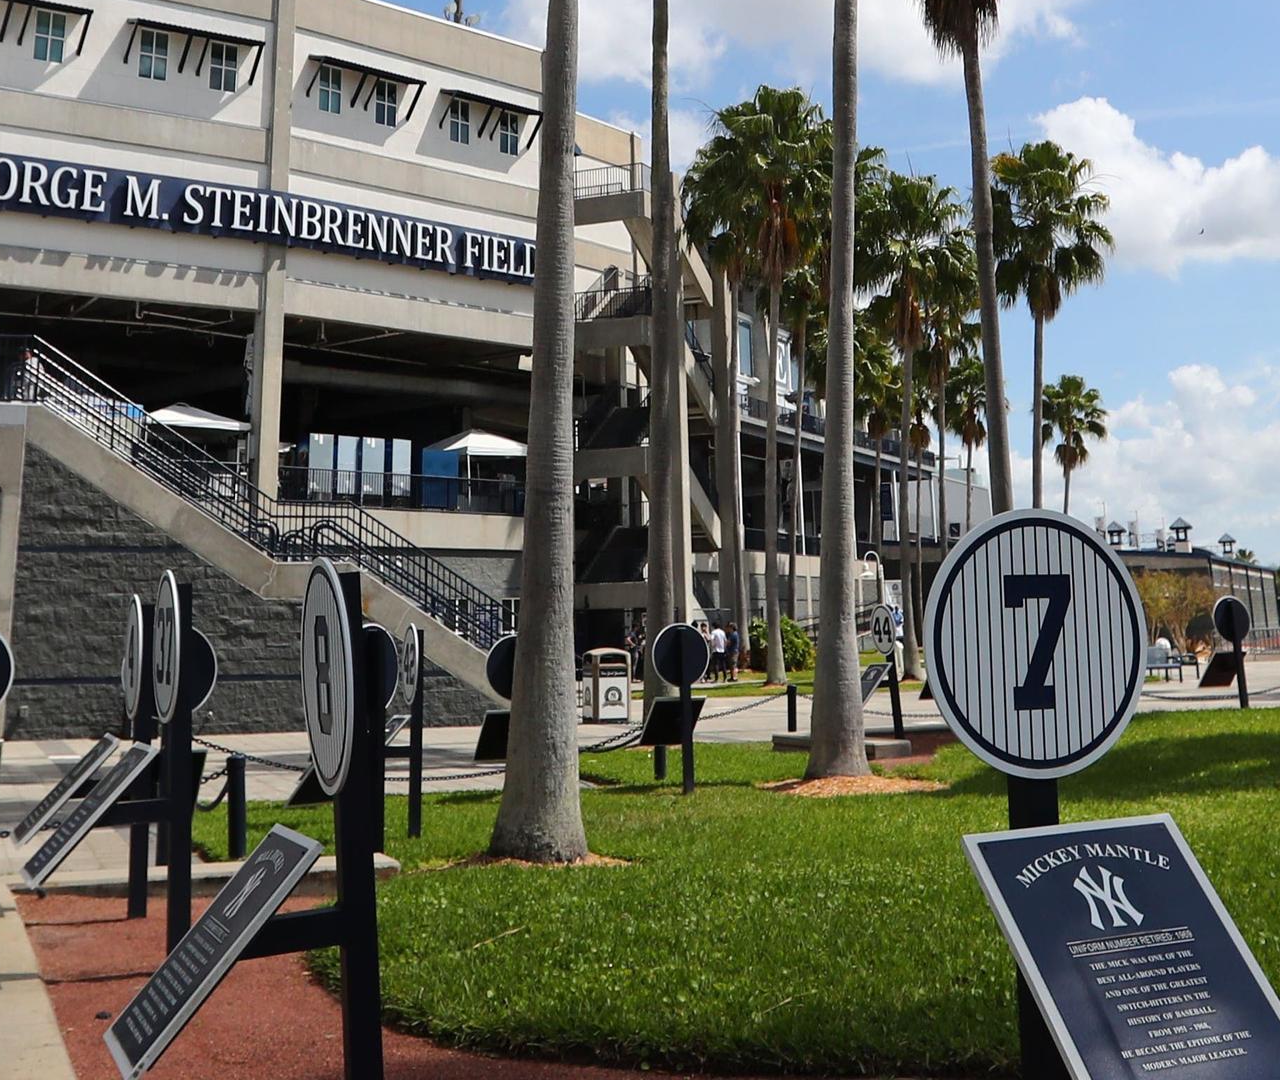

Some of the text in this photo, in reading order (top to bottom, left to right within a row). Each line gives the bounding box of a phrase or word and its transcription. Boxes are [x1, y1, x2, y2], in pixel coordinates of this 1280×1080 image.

[123, 175, 169, 220] M.
[183, 183, 456, 265] STEINBRENNER
[873, 616, 893, 643] 44
[155, 607, 172, 686] 37
[1003, 574, 1072, 712] 7
[313, 614, 333, 736] 8
[1015, 843, 1171, 888] MICKEY MANTLE
[1068, 942, 1107, 955] UNIFORM
[1106, 937, 1138, 950] NUMBER
[1140, 932, 1175, 945] RETIRED:
[1089, 949, 1194, 971] THE MICK WAS ONE OF THE
[1096, 963, 1201, 985] BEST ALL-AROUND PLAYERS
[1105, 976, 1208, 999] AND ONE OF THE GREATEST
[1117, 991, 1211, 1012] SWITCH-HITTERS IN THE
[1127, 1005, 1216, 1026] HISTORY OF BASEBALL.
[1121, 1030, 1252, 1059] HE BECAME THE EPITOME OF THE
[1148, 1027, 1172, 1038] FROM
[1142, 1047, 1247, 1071] MODERN MAJOR LEAGUER.
